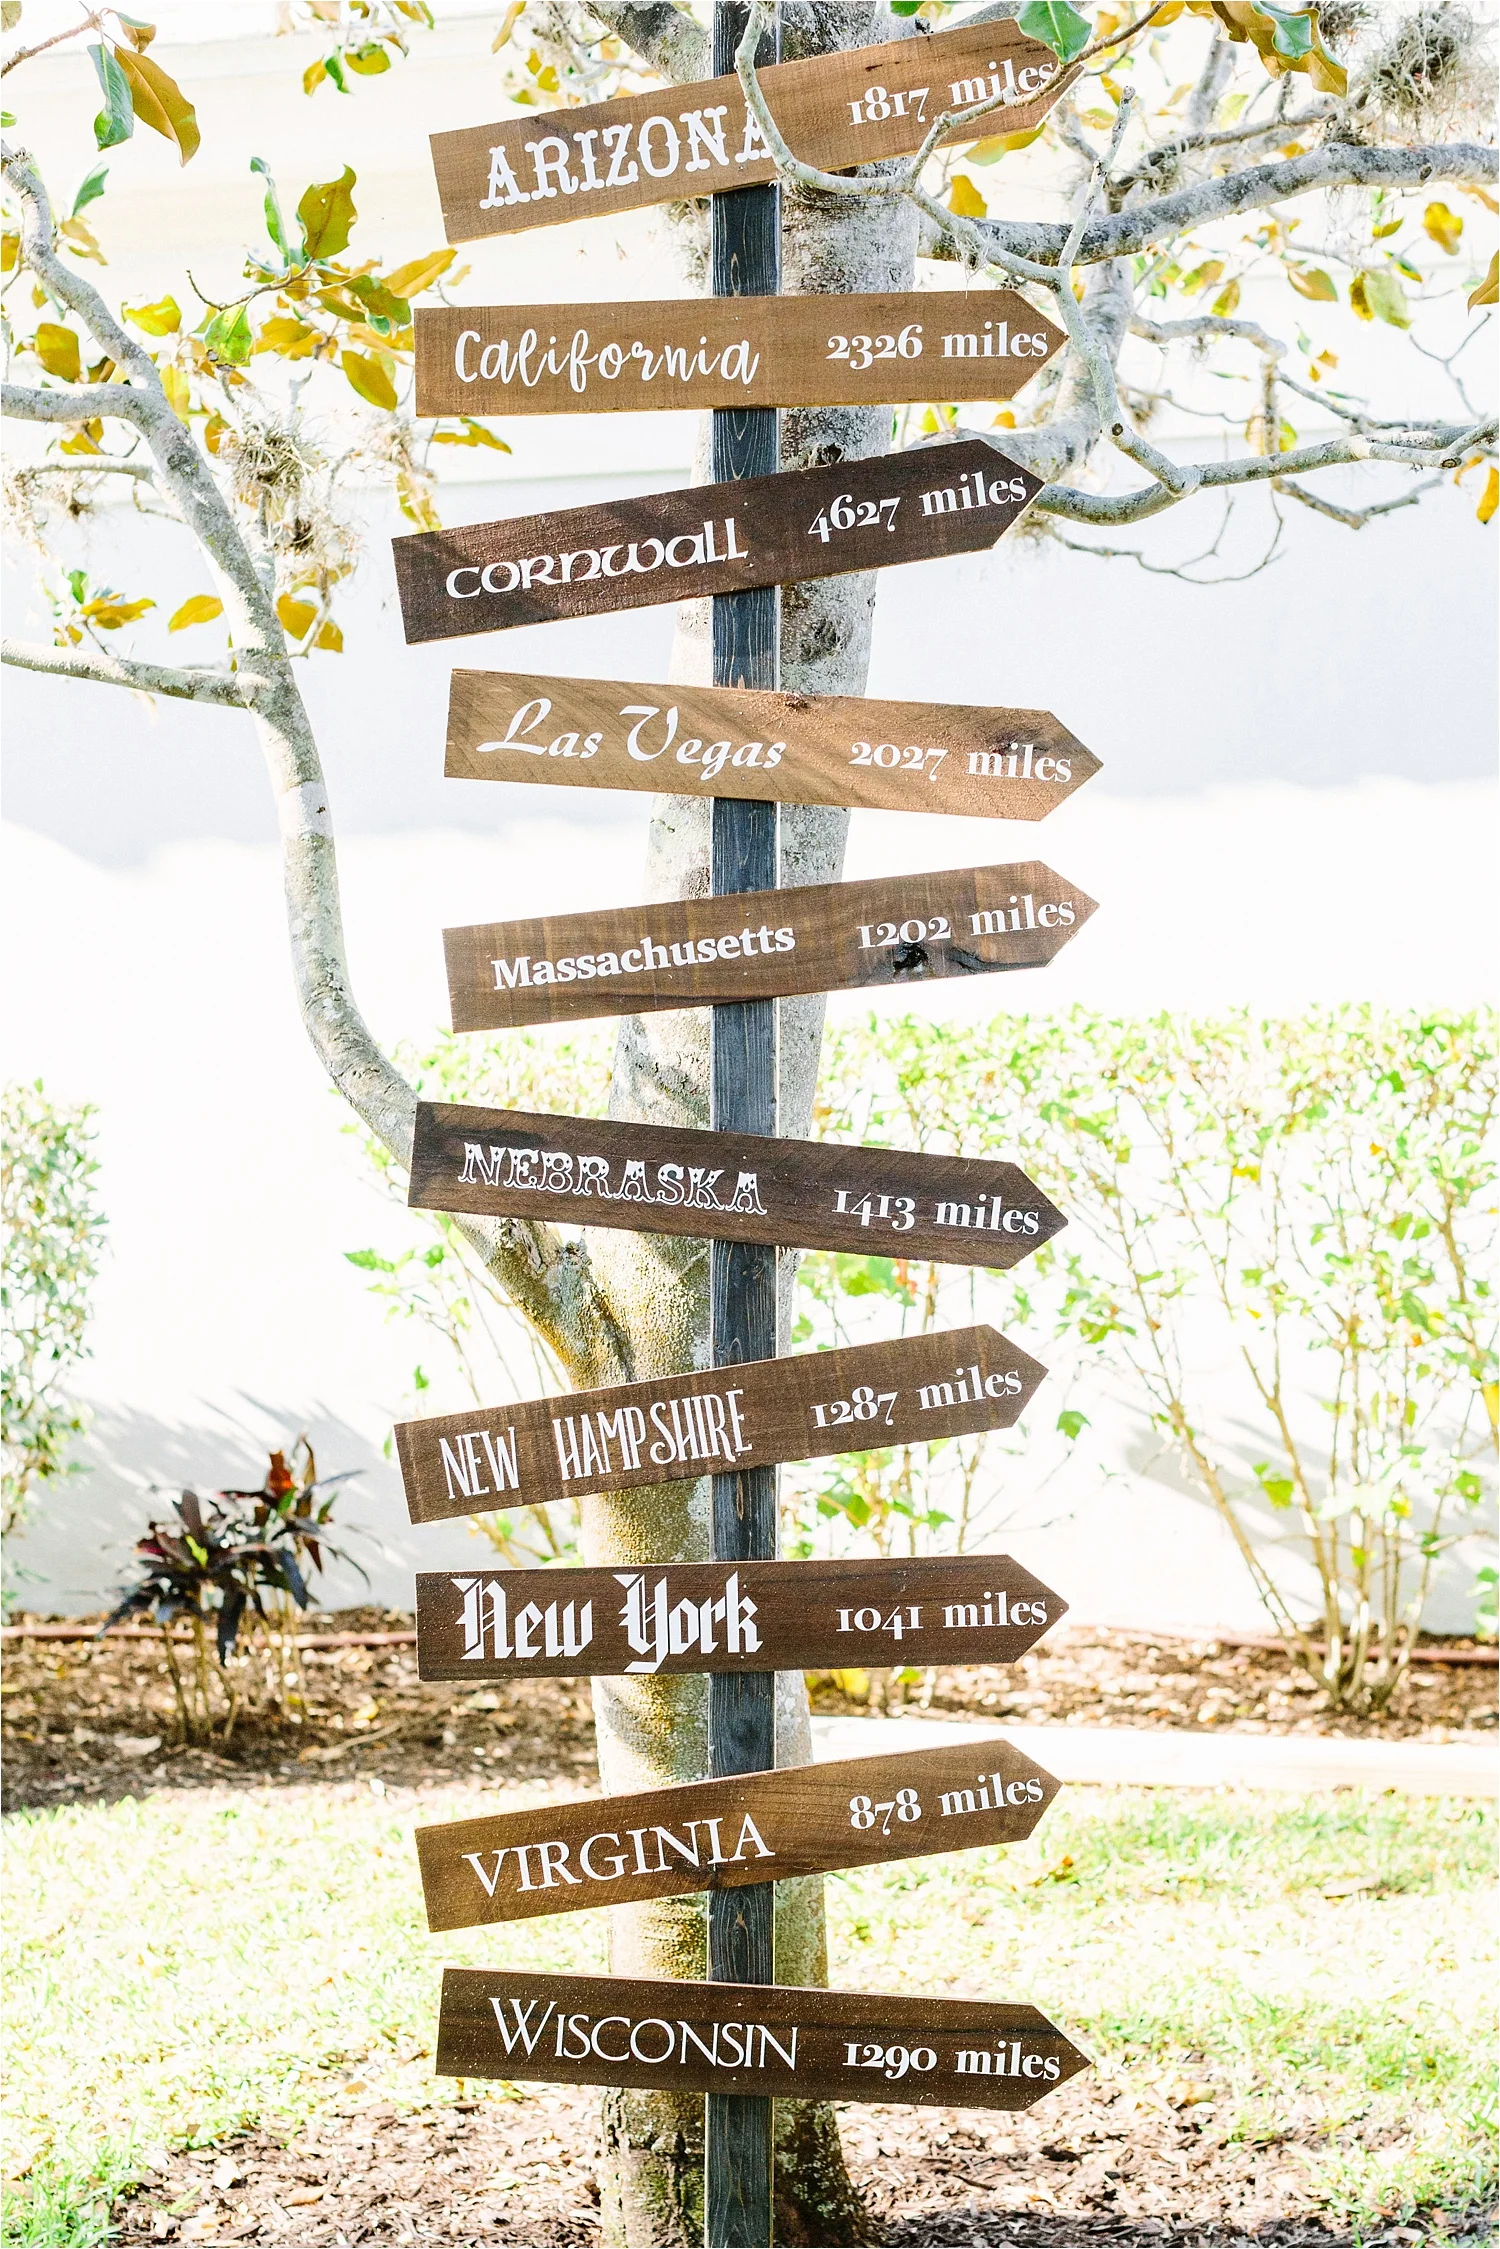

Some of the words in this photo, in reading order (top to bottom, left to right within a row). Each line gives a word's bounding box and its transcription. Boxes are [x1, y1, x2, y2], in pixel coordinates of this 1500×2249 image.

[480, 101, 772, 209] ARIZONA
[847, 86, 930, 125] 1817
[949, 59, 1055, 106] miles
[455, 329, 759, 392] California
[826, 327, 922, 369] 2326
[941, 321, 1049, 358] miles
[808, 495, 900, 543] 4627
[919, 473, 1027, 516] miles
[476, 698, 603, 758] Las
[620, 706, 787, 780] Vegas
[849, 742, 946, 781] 2027
[965, 743, 1071, 782] miles
[490, 925, 795, 990] Massachusetts
[856, 917, 951, 949] 1202
[968, 895, 1076, 936] miles
[456, 1142, 767, 1215] NEBRASKA
[833, 1190, 916, 1231] 1413
[934, 1194, 1040, 1235] miles
[439, 1427, 519, 1499] NEW
[552, 1389, 752, 1480] HAMPSHIRE
[810, 1387, 898, 1428] 1287
[917, 1365, 1022, 1410] miles
[452, 1577, 593, 1660] New
[614, 1571, 763, 1675] York
[836, 1606, 922, 1640] 1041
[942, 1591, 1048, 1628] miles
[462, 1813, 776, 1897] VIRGINIA
[850, 1789, 921, 1835] 878
[938, 1774, 1043, 1816] miles
[843, 2043, 937, 2079] 1290
[955, 2041, 1060, 2080] miles
